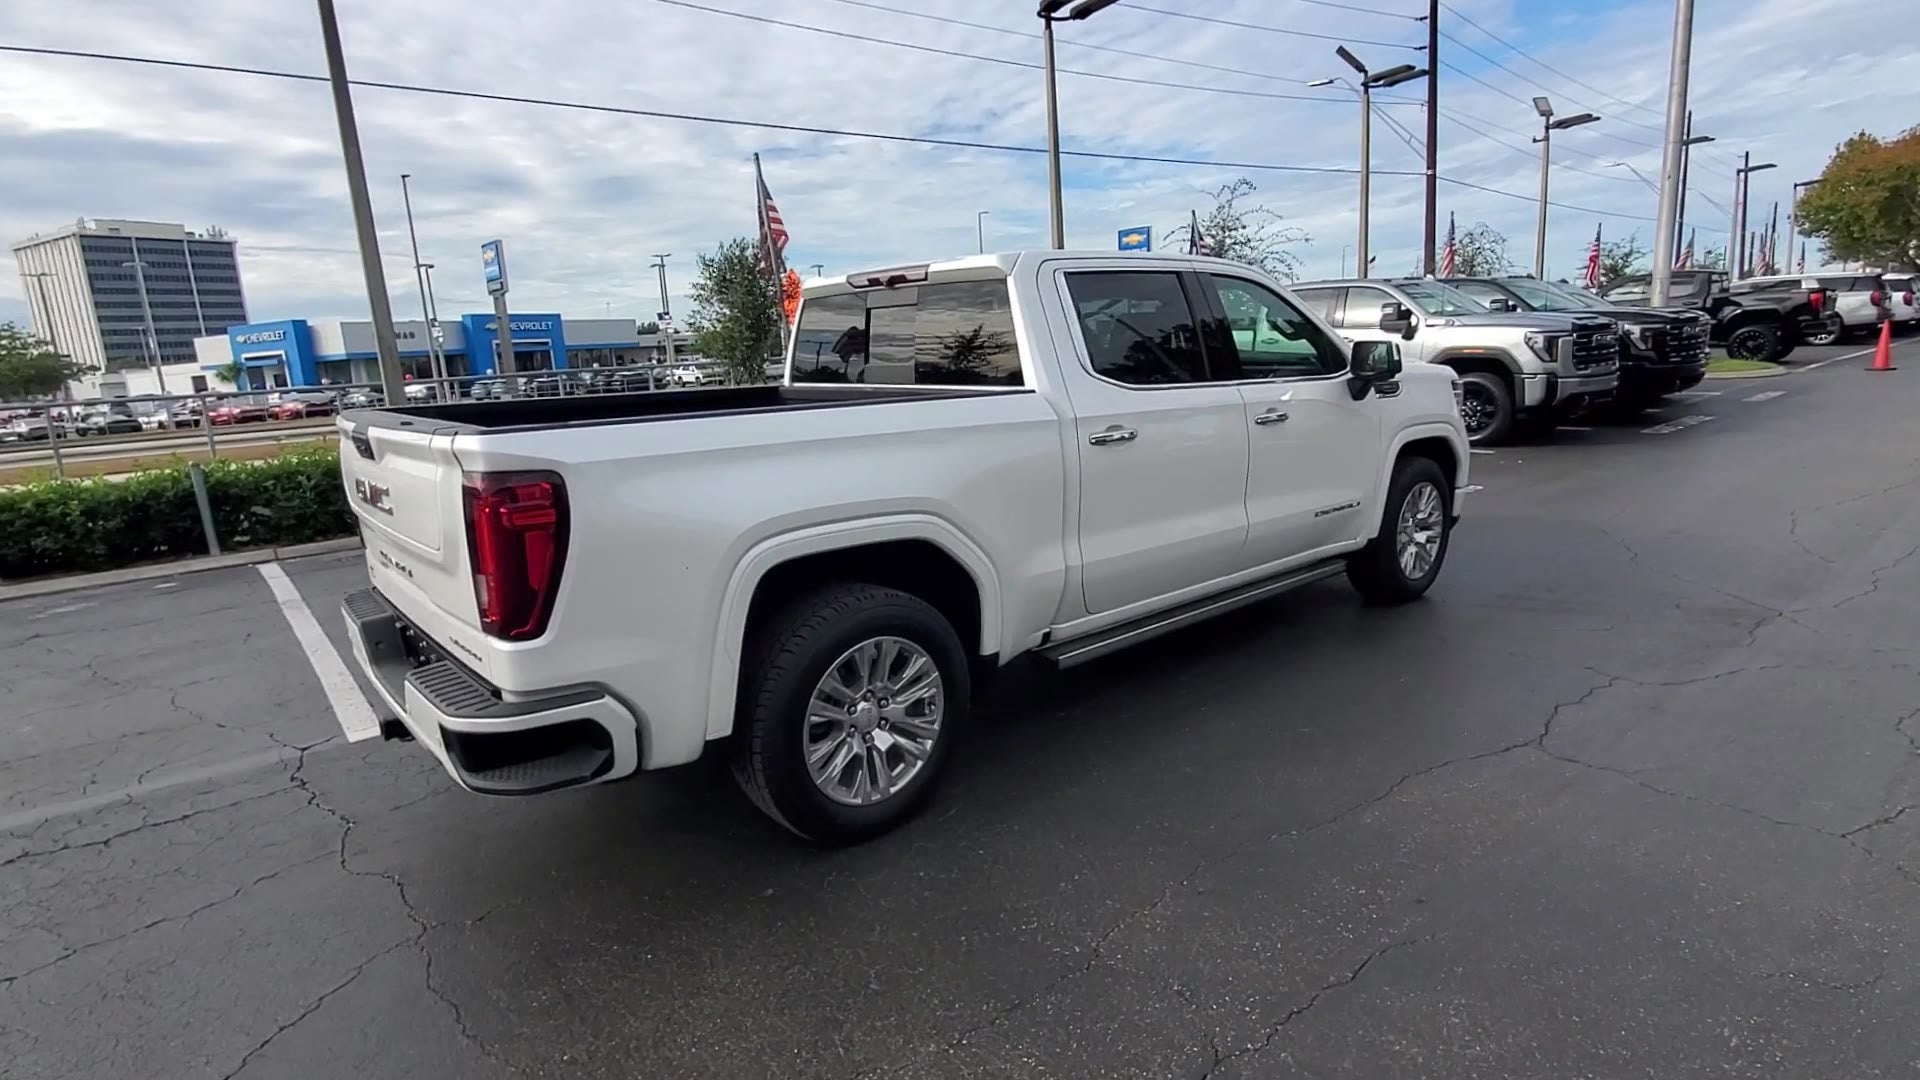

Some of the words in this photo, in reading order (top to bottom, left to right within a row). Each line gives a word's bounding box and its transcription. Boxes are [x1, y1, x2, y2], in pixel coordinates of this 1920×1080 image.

[508, 321, 553, 331] HEVROLET
[245, 330, 285, 344] CHEVROLET
[395, 331, 416, 340] MAN
